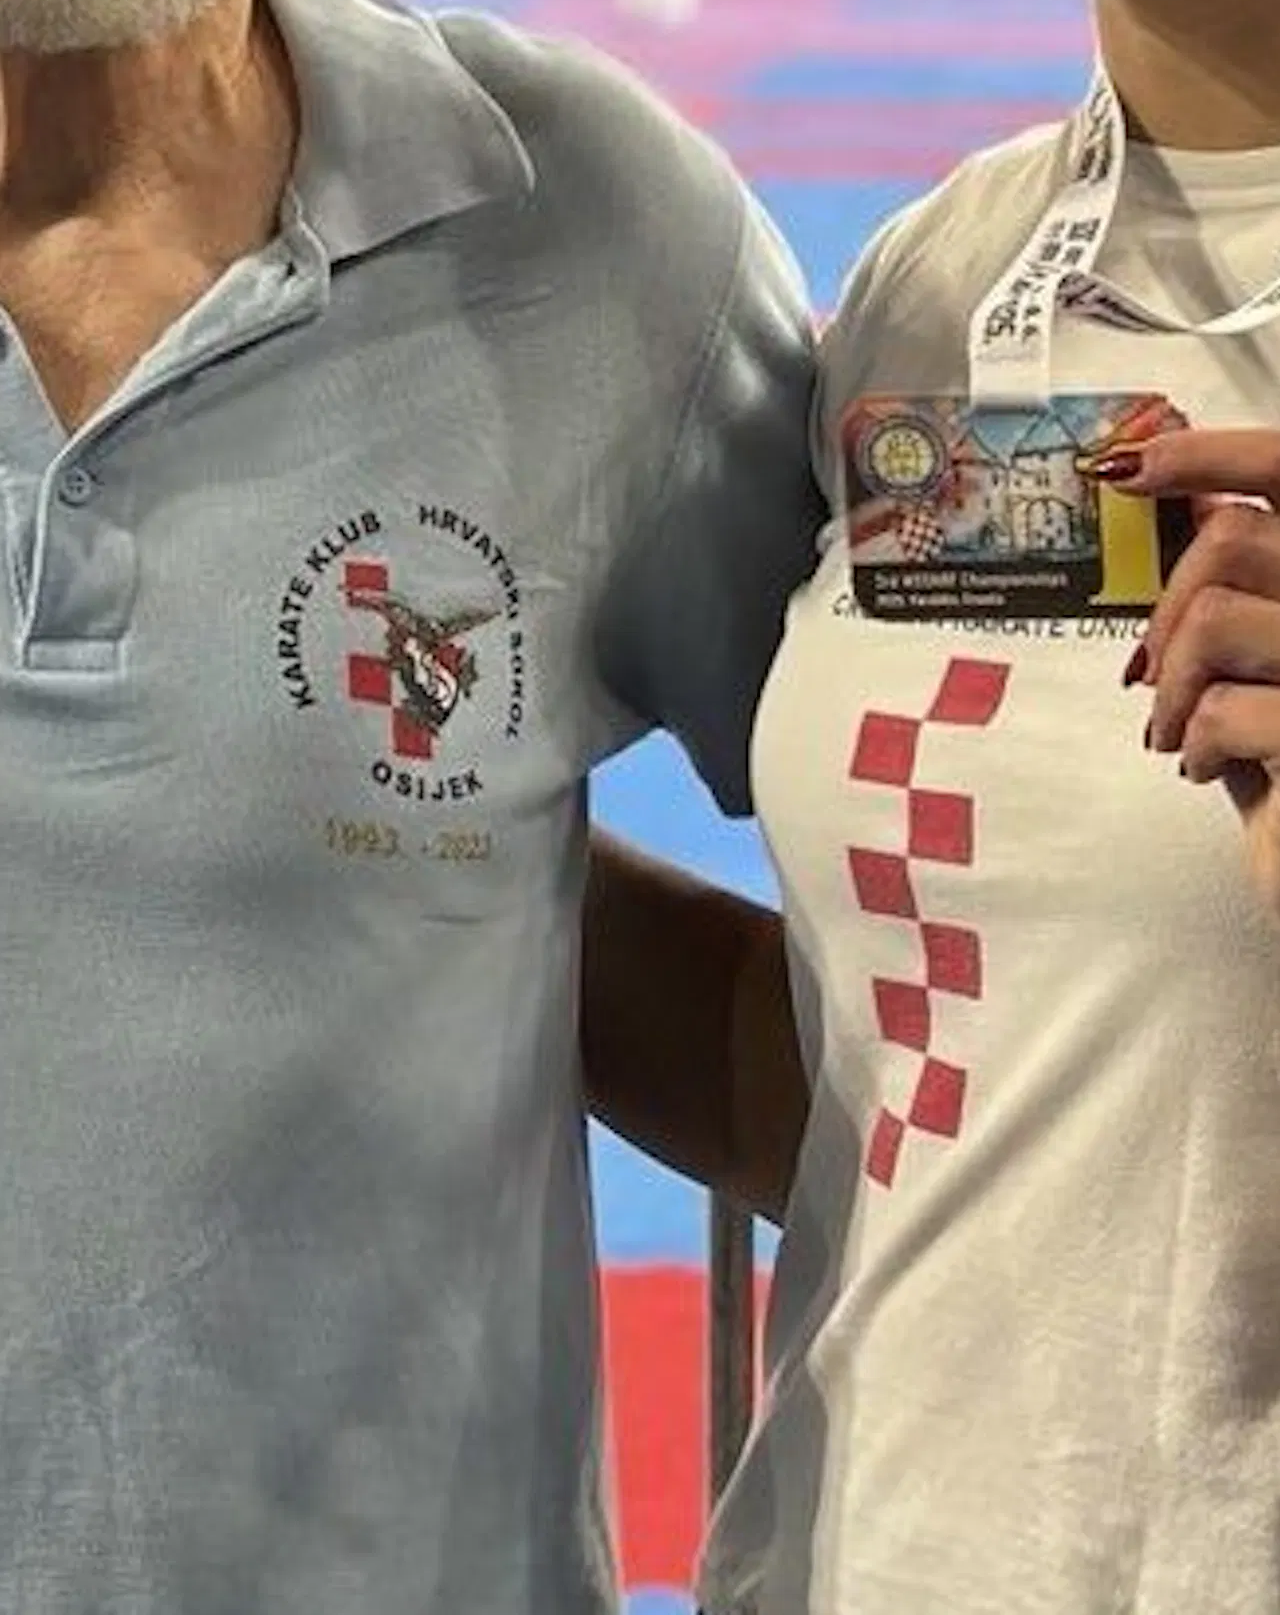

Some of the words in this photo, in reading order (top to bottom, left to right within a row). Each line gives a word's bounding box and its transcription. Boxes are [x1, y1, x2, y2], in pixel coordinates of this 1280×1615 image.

[278, 577, 315, 709] KARATE
[306, 511, 381, 572] KLUB
[419, 504, 519, 619] HRVATSKI
[371, 761, 484, 801] OSIJEK
